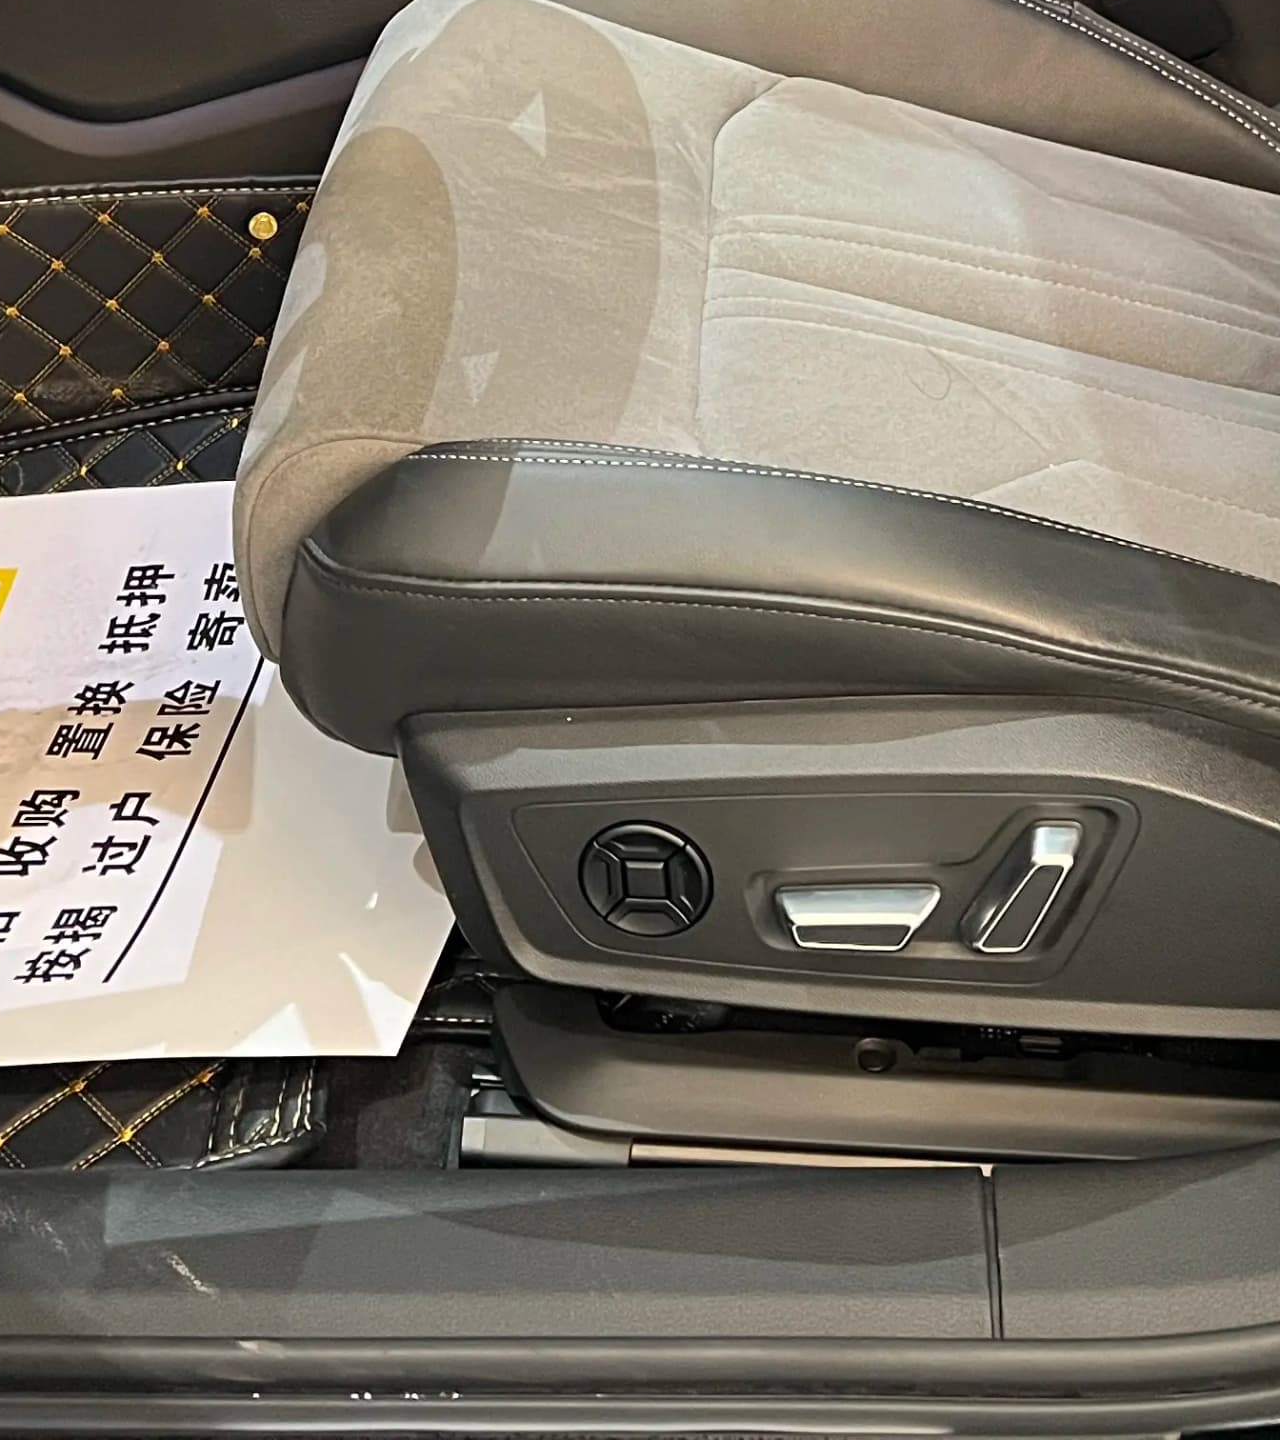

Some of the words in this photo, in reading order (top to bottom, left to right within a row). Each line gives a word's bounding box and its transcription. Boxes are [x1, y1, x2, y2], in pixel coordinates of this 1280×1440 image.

[46, 681, 134, 760] 置换
[98, 565, 174, 653] 抵押
[15, 906, 117, 983] 按揭
[83, 792, 159, 875] 过户
[136, 680, 221, 760] 保险
